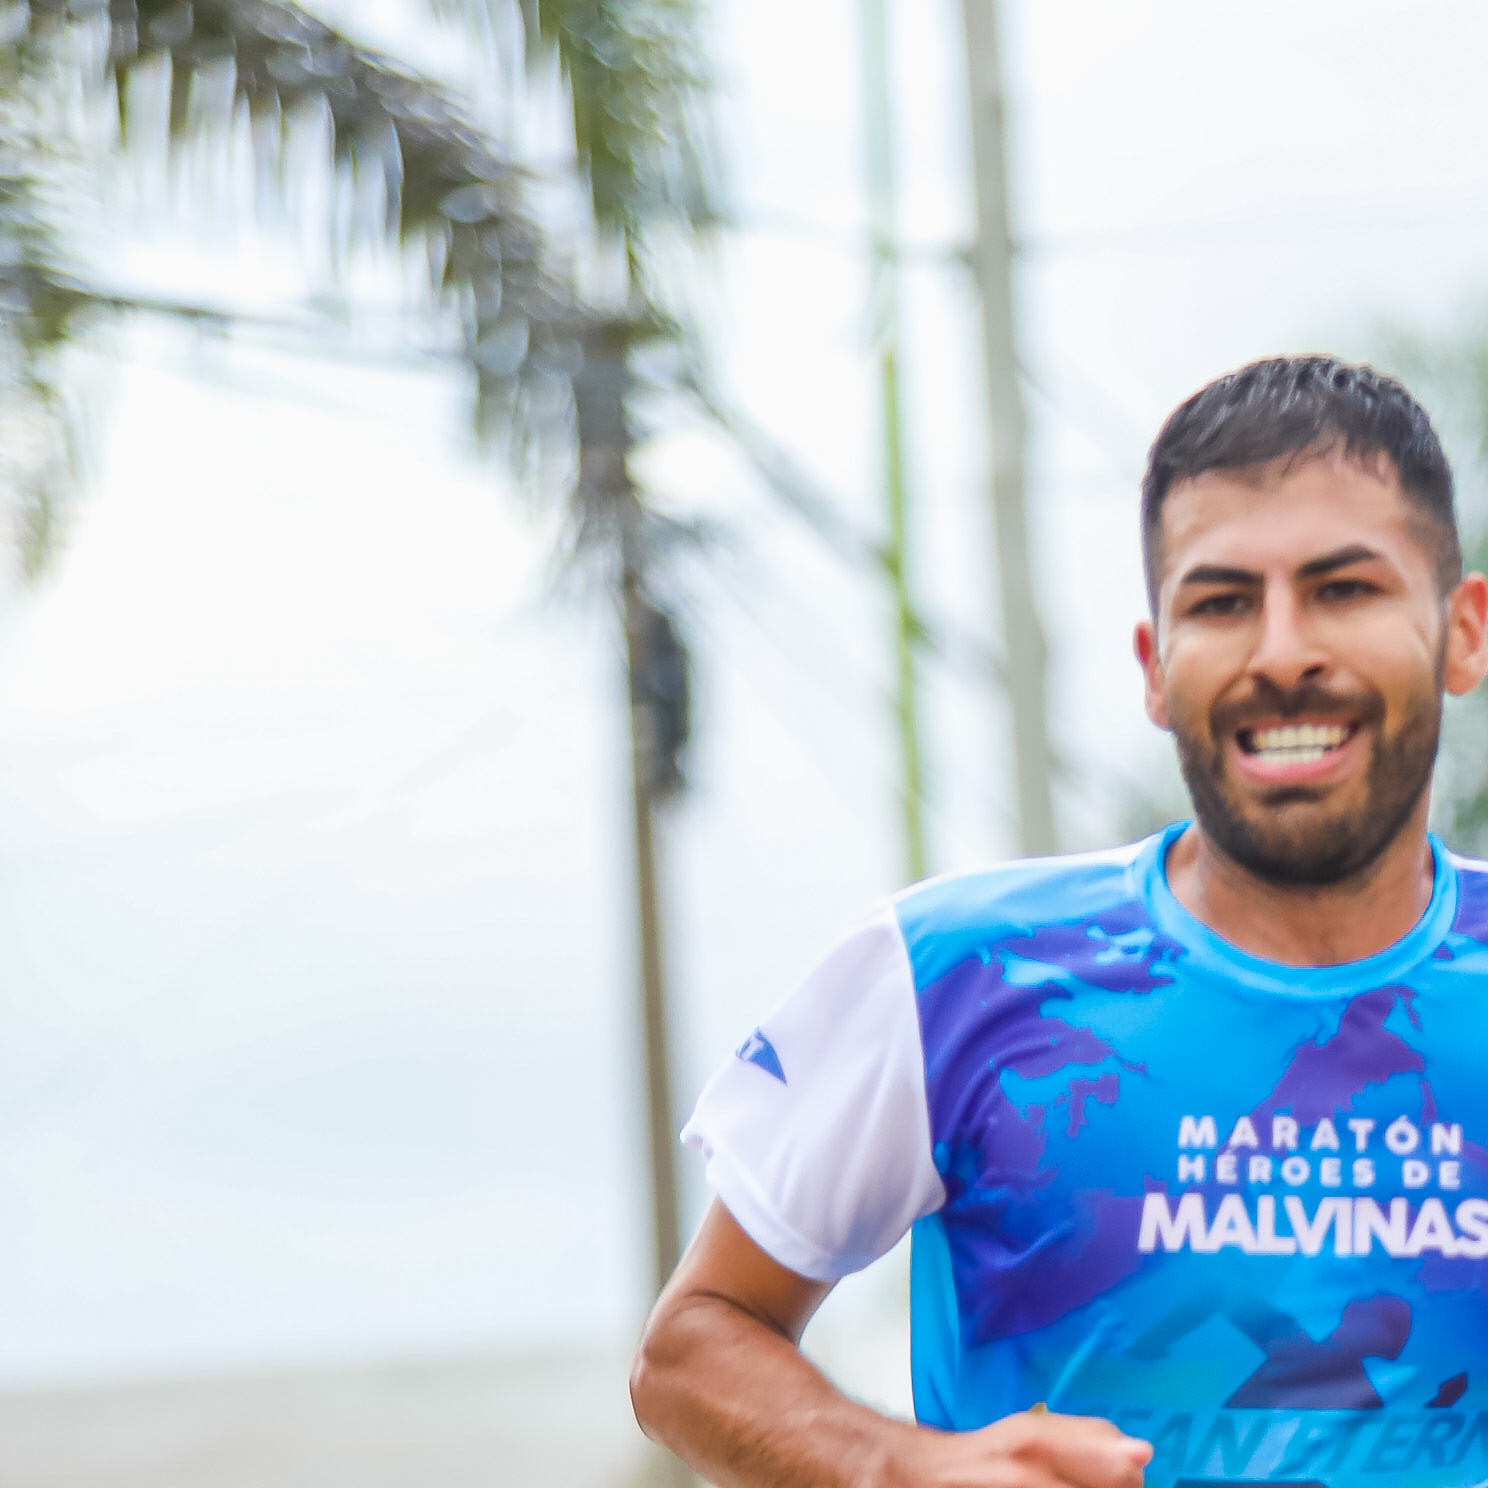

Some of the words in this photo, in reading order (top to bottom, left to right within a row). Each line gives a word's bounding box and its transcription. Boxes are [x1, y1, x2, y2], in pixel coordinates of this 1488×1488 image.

[1178, 1115, 1464, 1156] MARATÓN
[1178, 1152, 1376, 1188] HÉROES
[1403, 1160, 1462, 1191] DE
